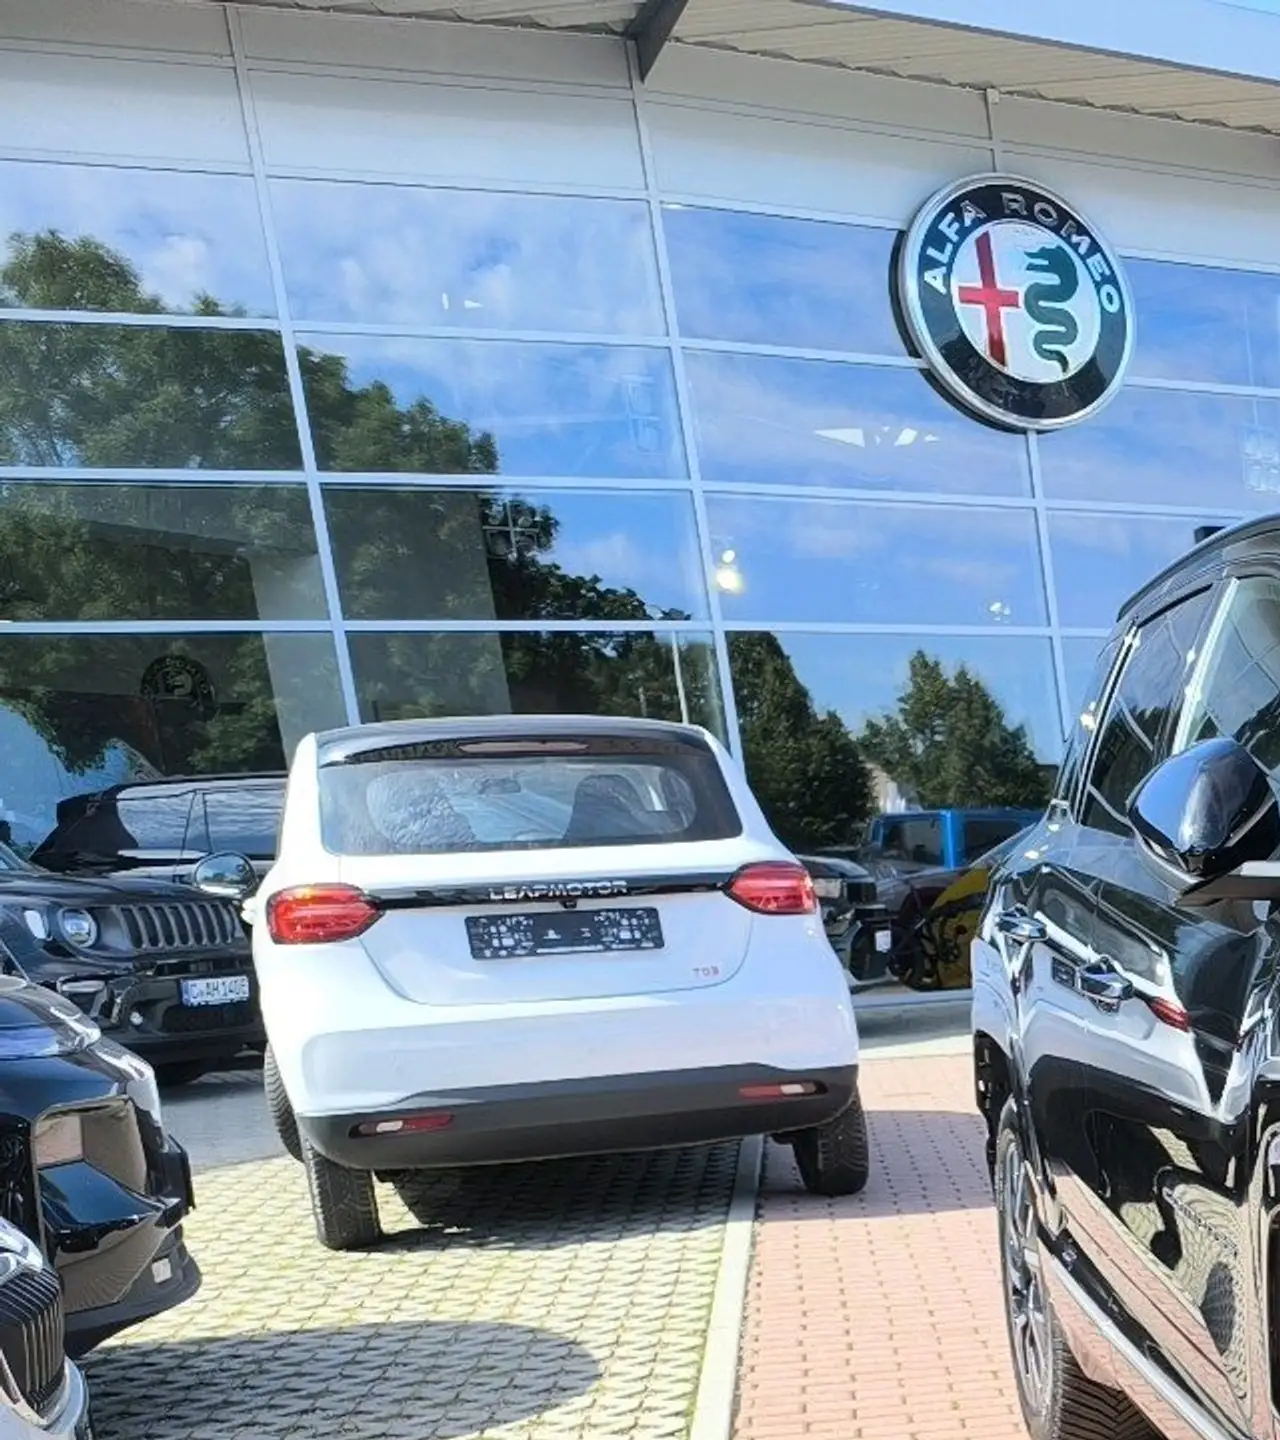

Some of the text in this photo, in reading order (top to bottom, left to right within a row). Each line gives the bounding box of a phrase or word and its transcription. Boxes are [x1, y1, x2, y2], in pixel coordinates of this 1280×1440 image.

[924, 192, 1121, 314] ALFA ROMEO
[489, 880, 628, 900] LEAPMOTOR
